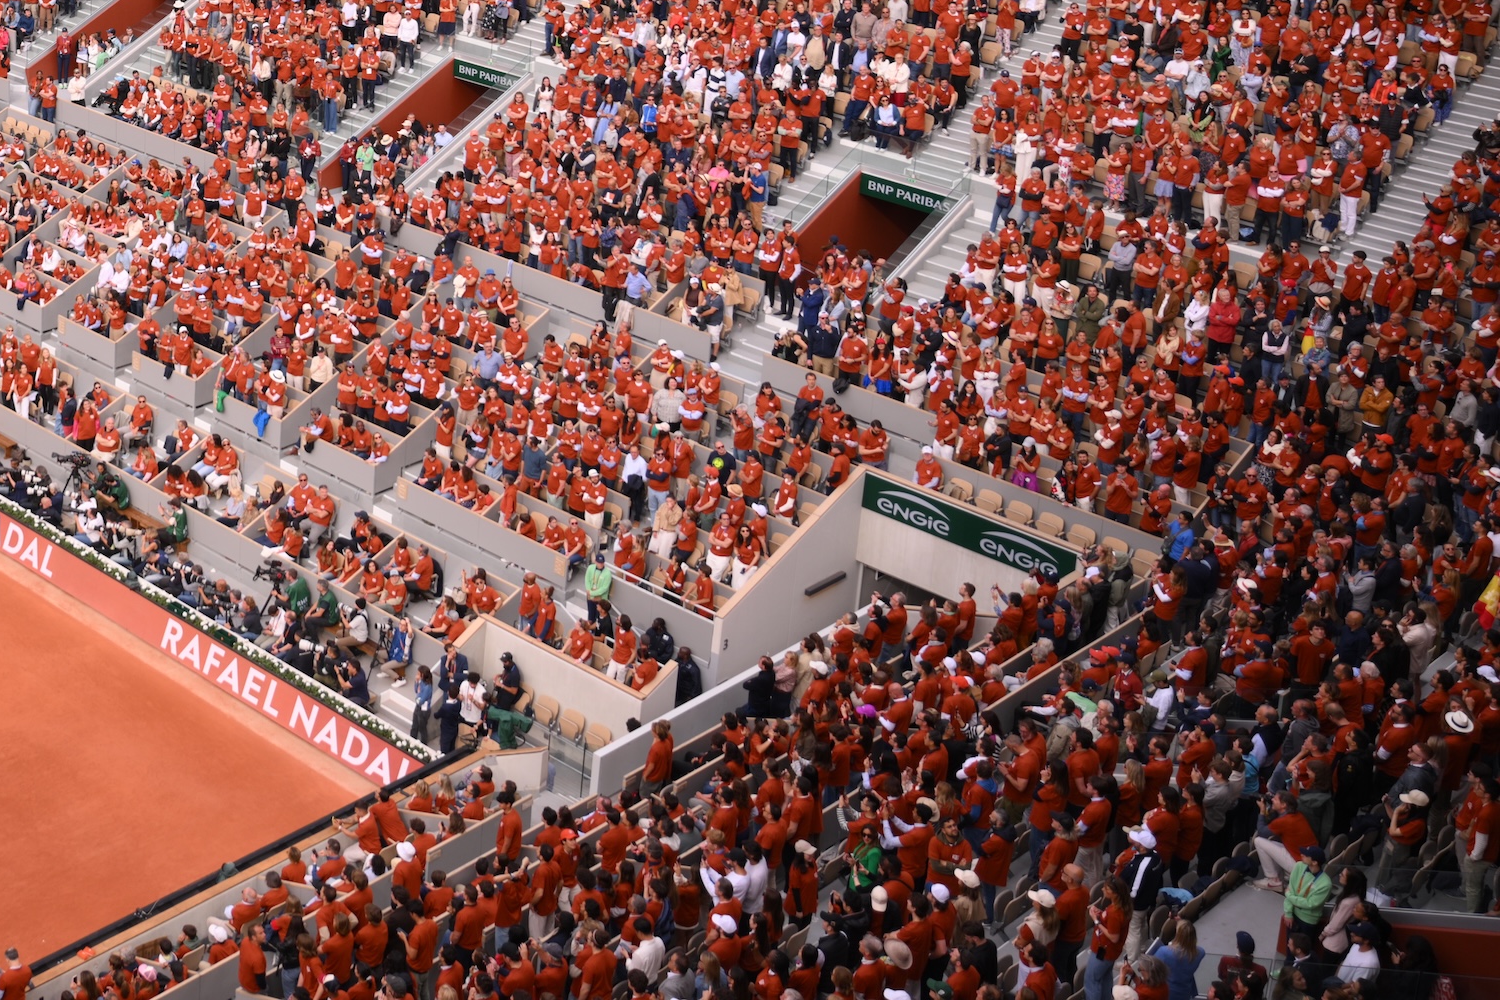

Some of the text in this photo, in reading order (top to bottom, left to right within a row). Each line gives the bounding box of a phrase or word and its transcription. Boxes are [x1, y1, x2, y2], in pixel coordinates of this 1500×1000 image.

[459, 64, 478, 77] BNP
[867, 180, 951, 212] BNP PARIBAS
[161, 618, 279, 718] RAFAEL
